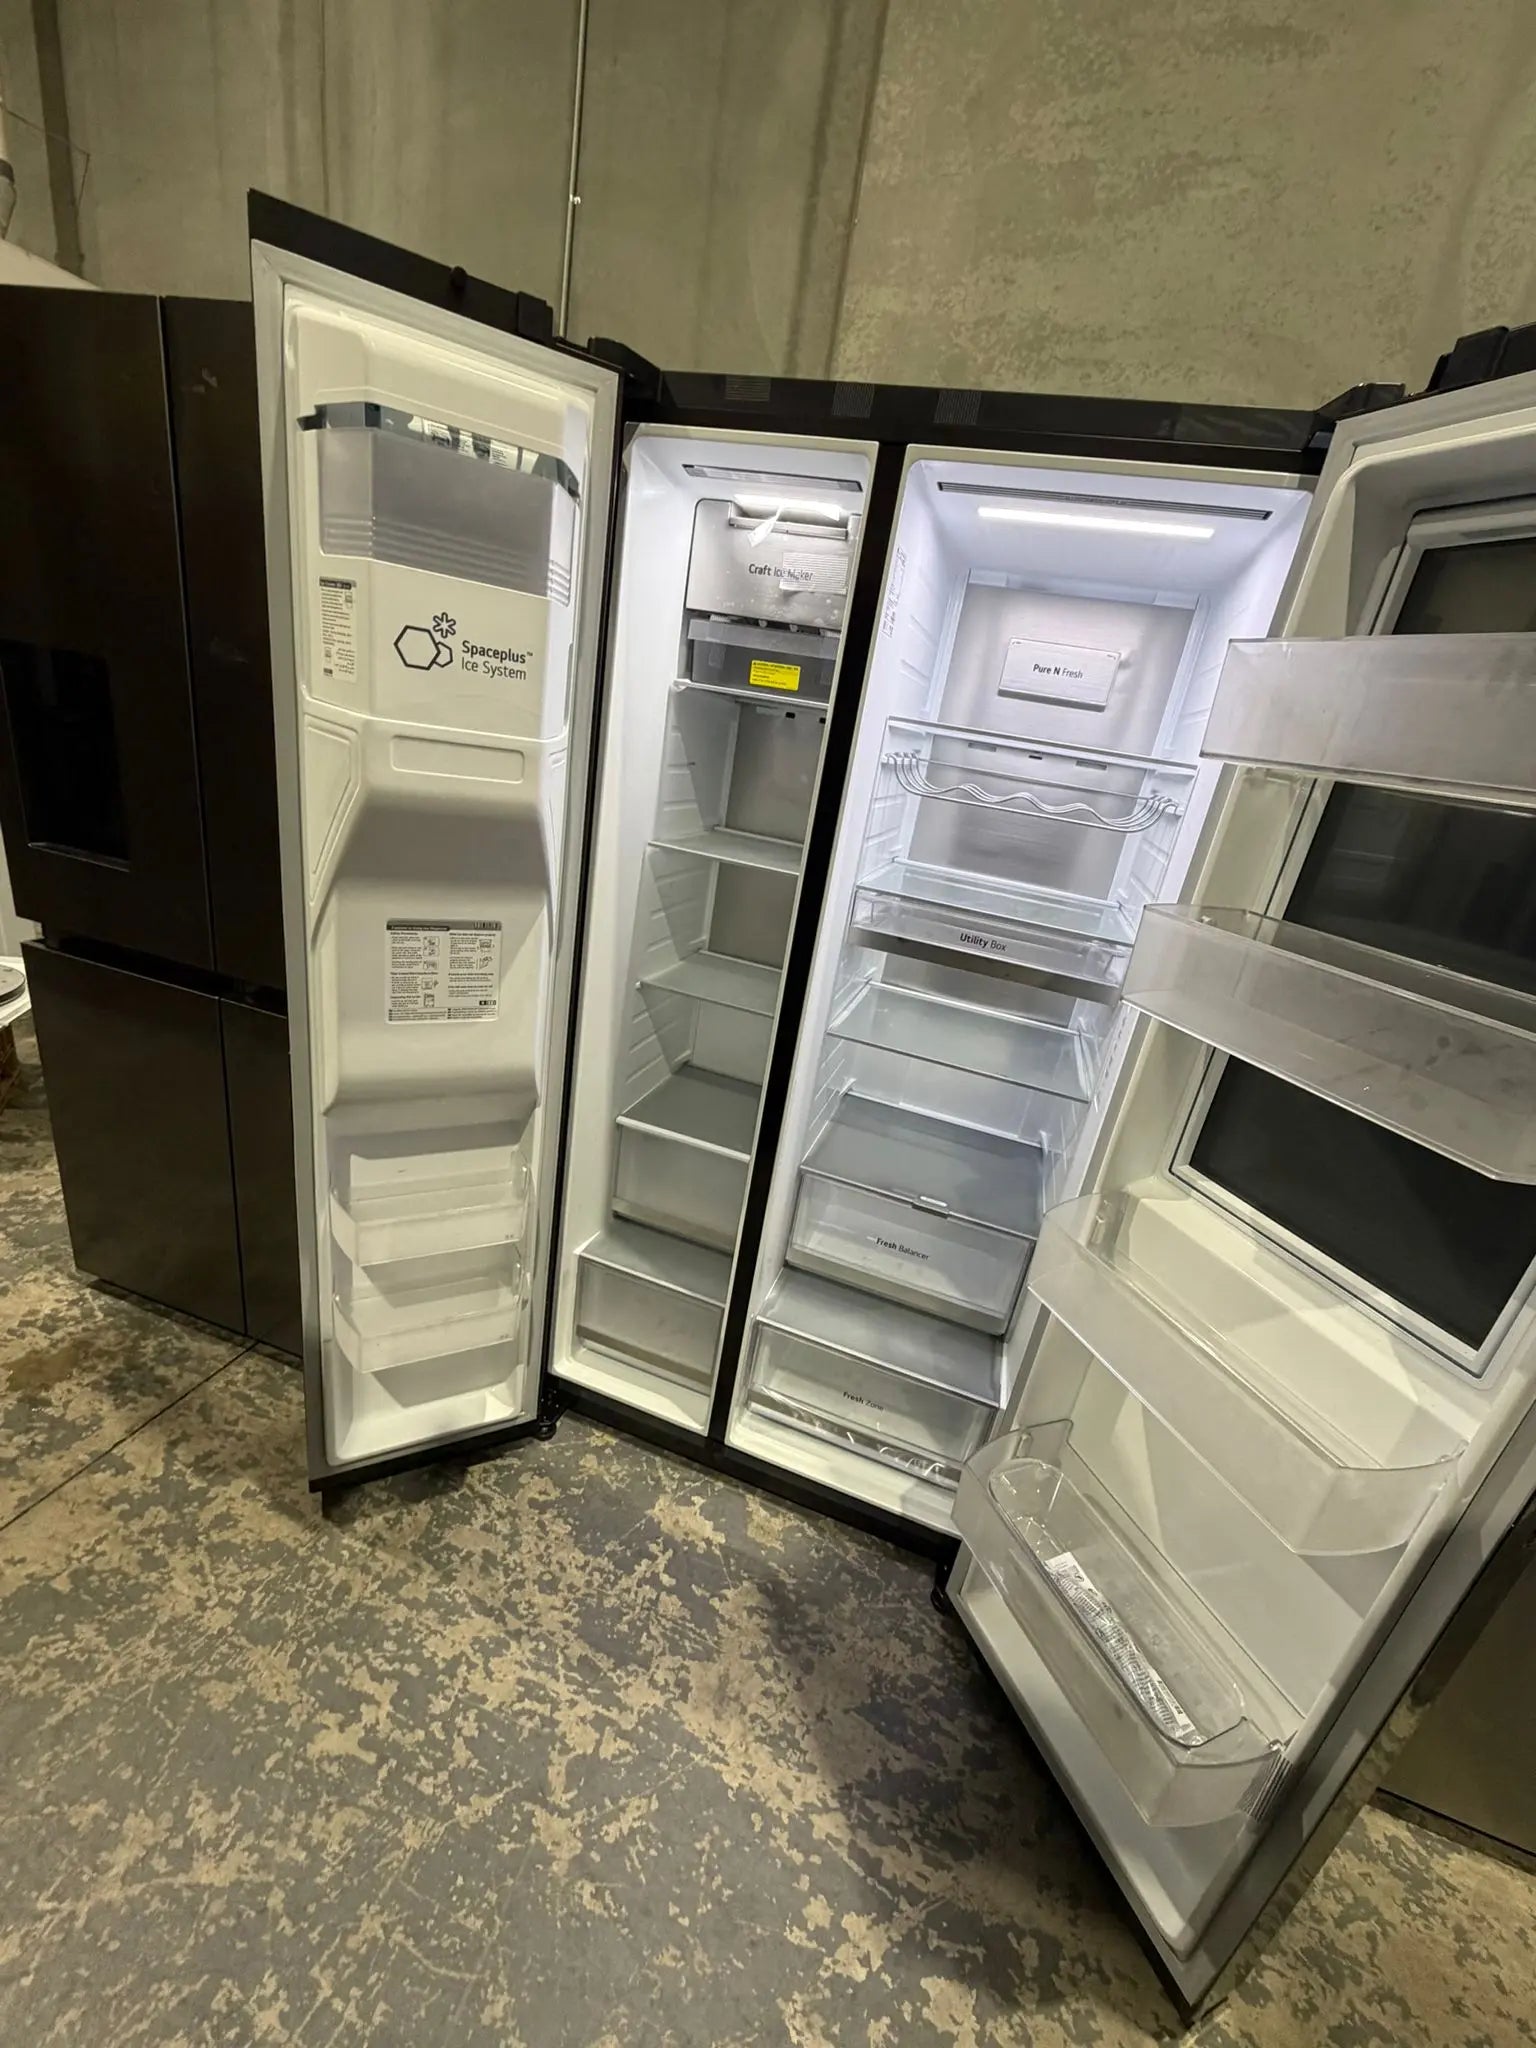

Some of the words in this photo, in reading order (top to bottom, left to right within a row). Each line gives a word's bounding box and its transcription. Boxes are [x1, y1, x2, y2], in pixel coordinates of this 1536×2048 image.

[748, 563, 772, 578] Craft
[461, 657, 479, 672] Ice
[482, 660, 527, 680] System
[1032, 663, 1052, 675] Pure
[1053, 666, 1061, 676] N
[1061, 667, 1083, 679] Fresh
[960, 932, 988, 949] Utility
[990, 939, 1007, 952] Box
[876, 1237, 897, 1250] Fresh
[898, 1244, 929, 1261] Balancer
[843, 1391, 864, 1404] Fresh
[865, 1400, 885, 1412] Zone
